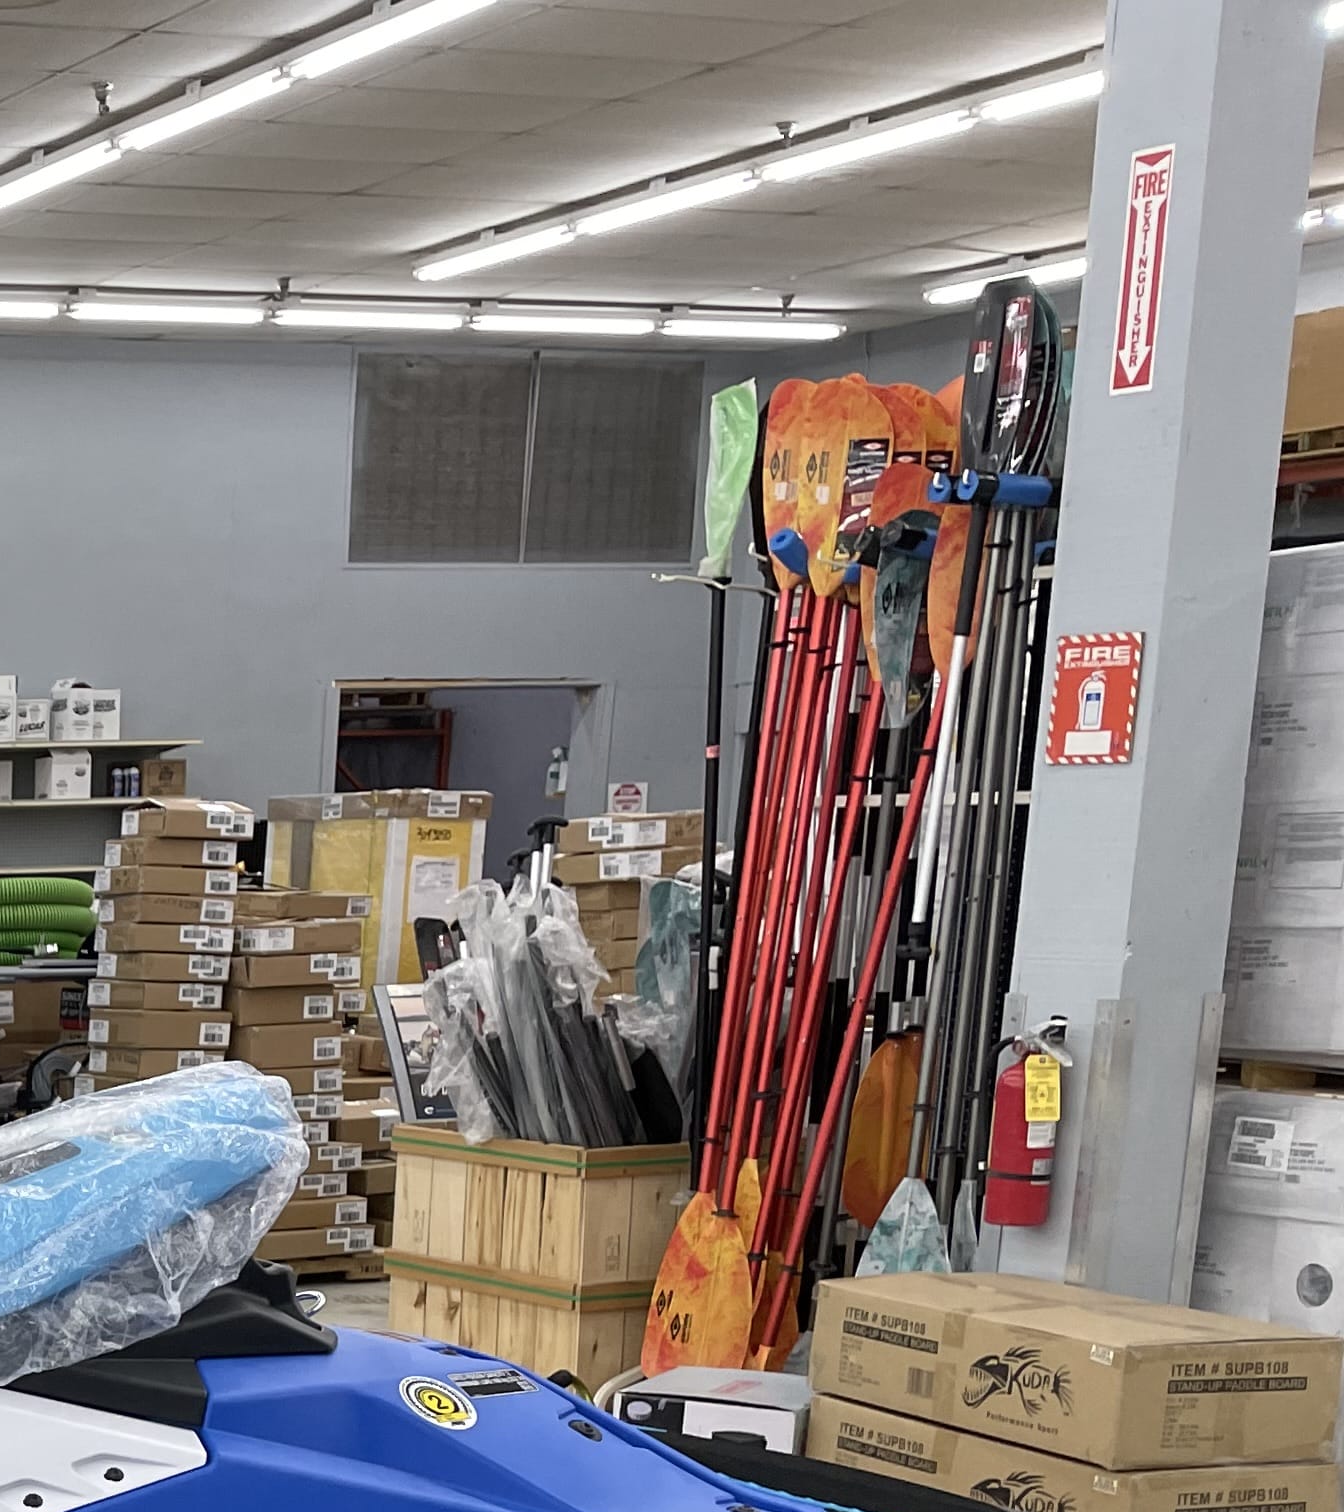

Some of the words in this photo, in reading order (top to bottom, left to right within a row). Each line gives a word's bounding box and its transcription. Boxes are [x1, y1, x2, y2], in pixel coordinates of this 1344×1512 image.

[1133, 169, 1168, 200] FIRE
[1129, 200, 1153, 368] EXTINGUISHER
[1064, 644, 1132, 663] FIRE
[845, 1306, 870, 1323] ITEM
[880, 1314, 927, 1336] SUPB108
[1171, 1363, 1206, 1378] ITEM
[1211, 1363, 1220, 1375] #
[1224, 1361, 1289, 1376] SUPB108
[1169, 1379, 1223, 1393] STAND-UP
[1224, 1379, 1267, 1391] PADDLE
[1268, 1378, 1306, 1390] BOARD
[428, 1394, 450, 1410] 2
[839, 1421, 865, 1438] ITEM
[875, 1431, 925, 1456] SUPB108
[1177, 1491, 1211, 1506] ITEM
[1228, 1487, 1289, 1504] SUPB108
